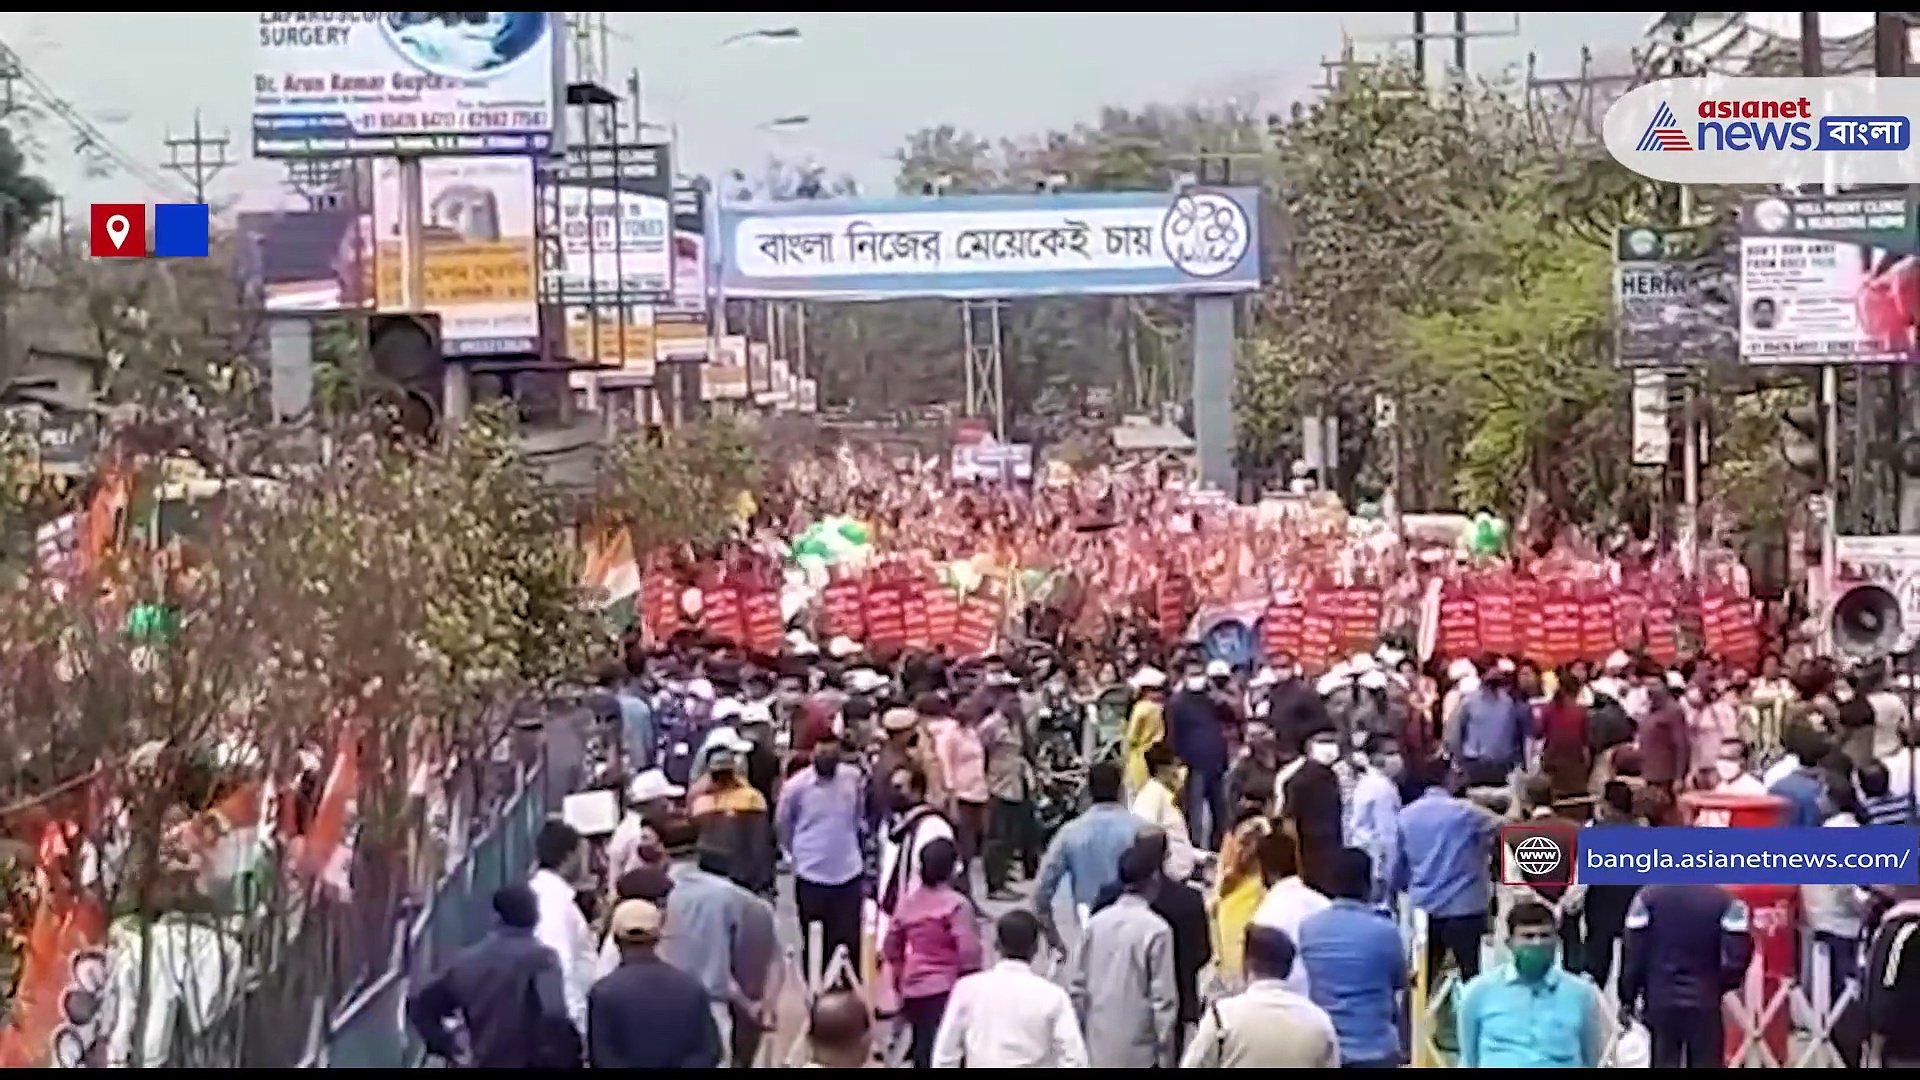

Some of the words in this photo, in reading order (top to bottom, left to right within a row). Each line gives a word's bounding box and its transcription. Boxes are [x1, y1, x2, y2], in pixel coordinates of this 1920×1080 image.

[260, 26, 349, 46] SURGERY
[756, 231, 833, 264] বাংলা
[845, 221, 941, 263] নিজের
[956, 219, 1089, 260] মেয়েকেই
[1105, 224, 1153, 257] চায়
